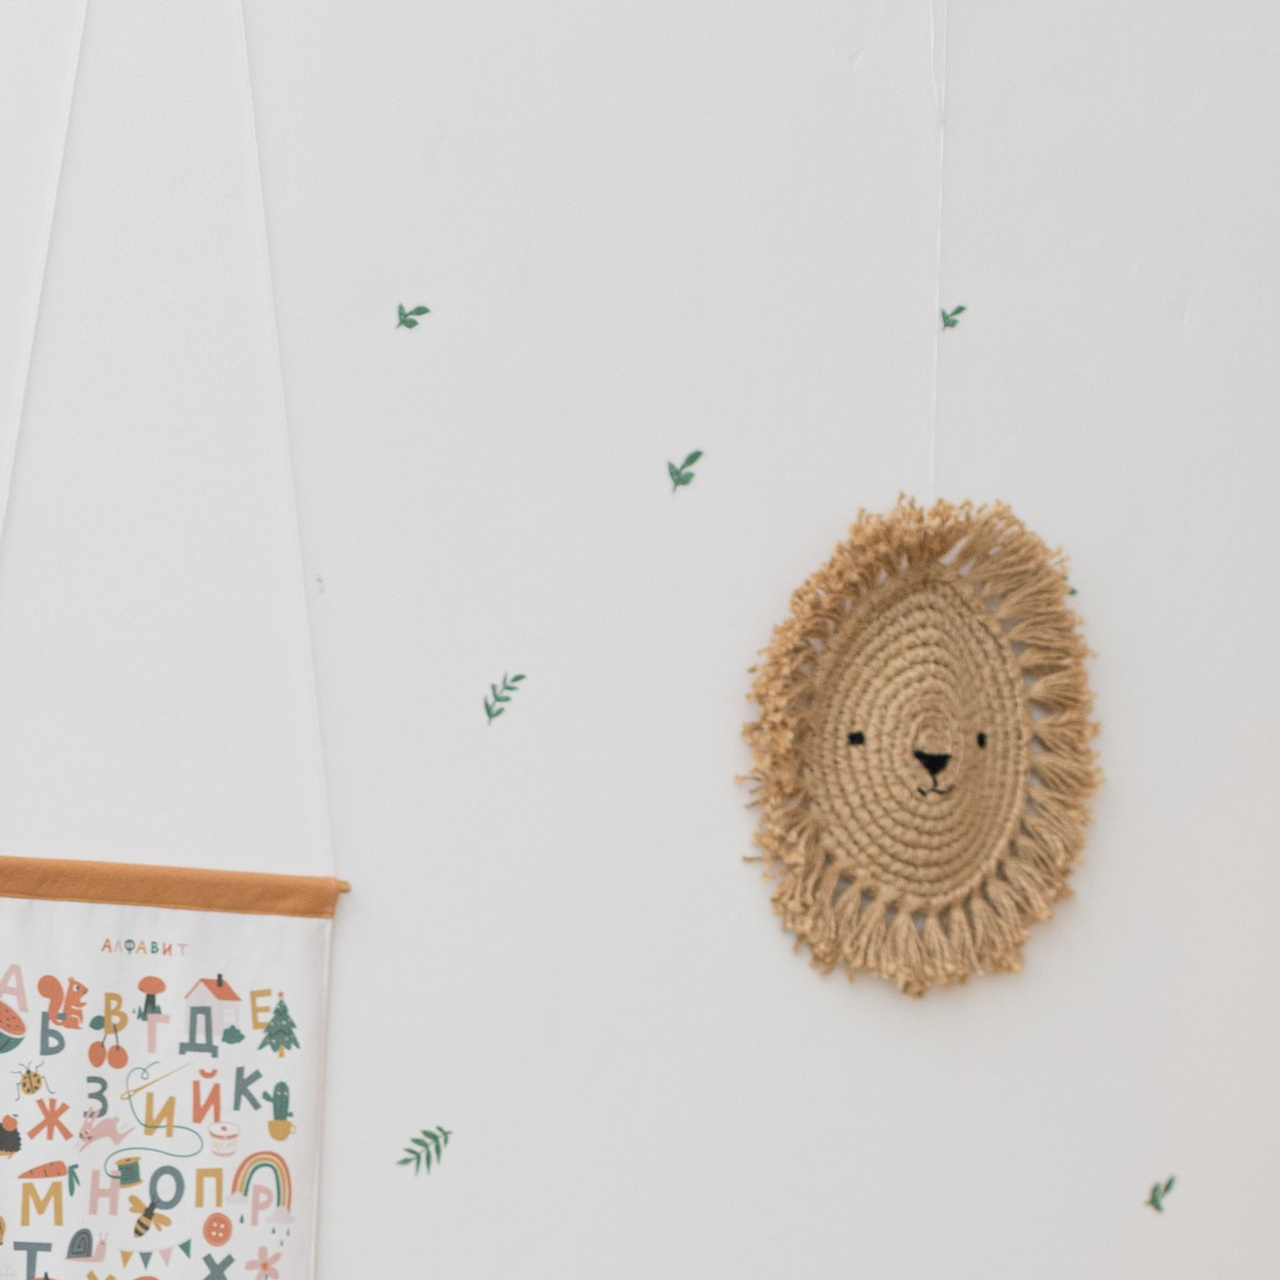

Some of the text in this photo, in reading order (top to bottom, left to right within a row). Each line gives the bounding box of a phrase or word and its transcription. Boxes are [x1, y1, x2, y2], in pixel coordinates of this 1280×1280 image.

[101, 937, 189, 957] АЛФАВИТ
[104, 992, 128, 1034] В
[146, 1013, 170, 1053] Г
[178, 1006, 219, 1058] Д
[250, 988, 272, 1030] Е
[26, 1097, 73, 1141] Ж
[83, 1075, 108, 1119] З
[143, 1092, 176, 1138] И
[192, 1068, 221, 1124] Й
[233, 1066, 263, 1111] К
[20, 1181, 64, 1227] М
[88, 1169, 121, 1216] Н
[149, 1165, 185, 1210] О
[194, 1167, 223, 1208] П
[250, 1184, 274, 1226] Р
[13, 1241, 53, 1280] Т
